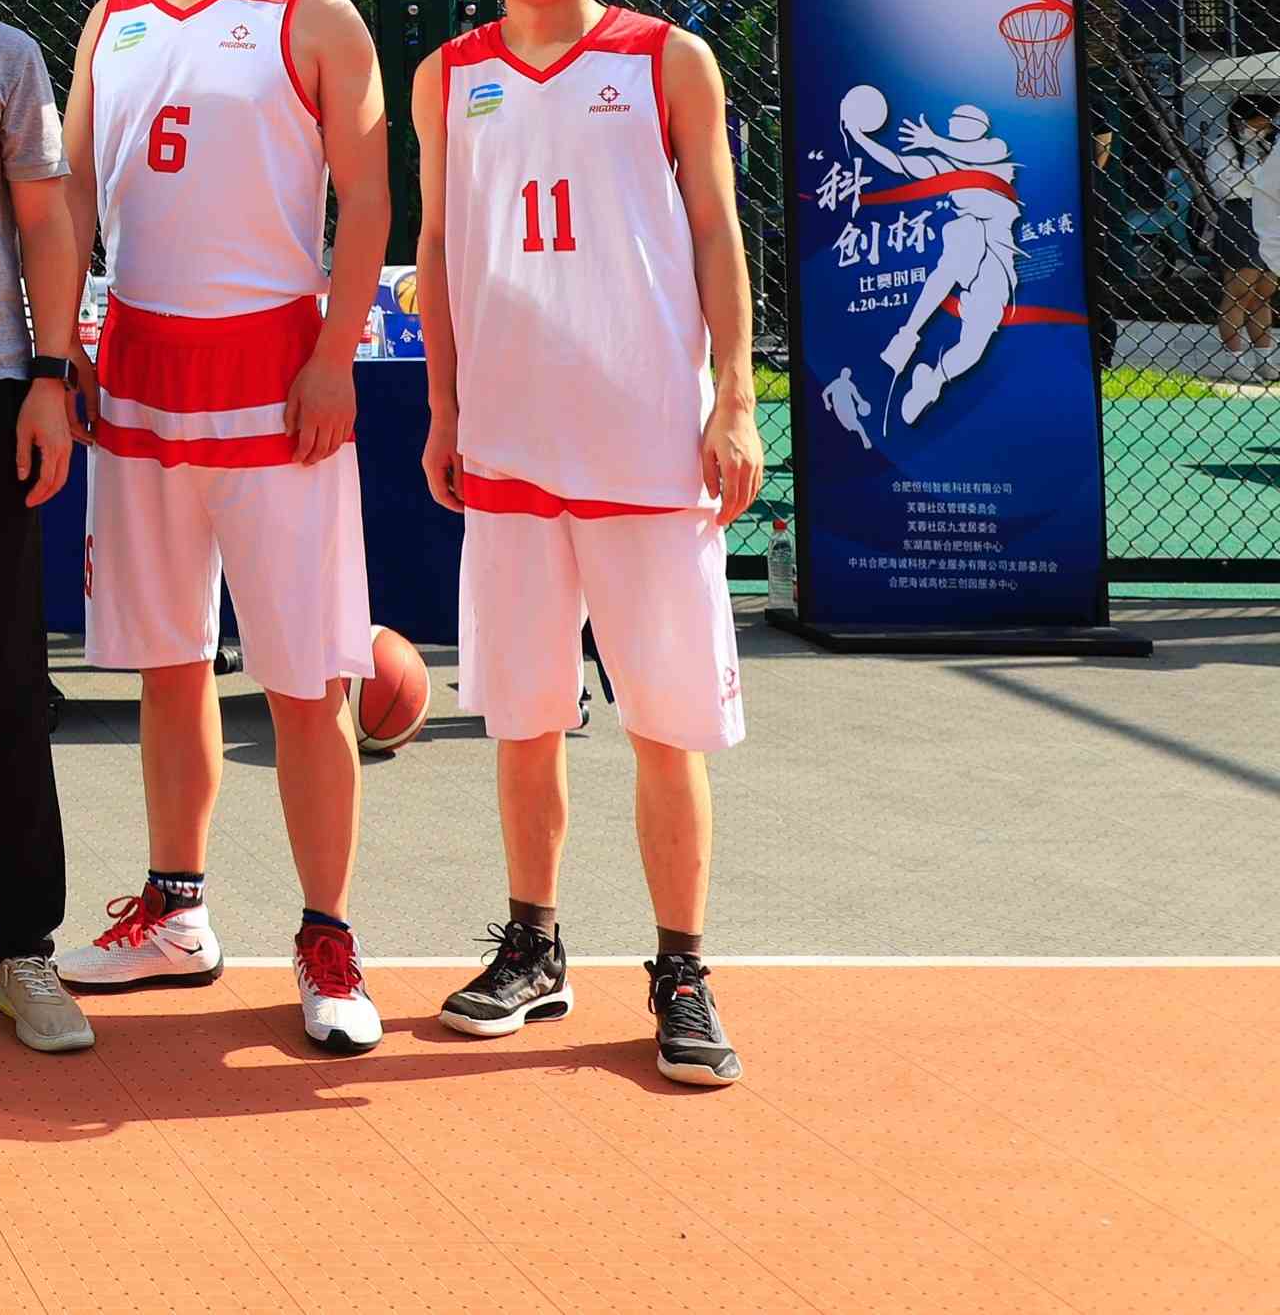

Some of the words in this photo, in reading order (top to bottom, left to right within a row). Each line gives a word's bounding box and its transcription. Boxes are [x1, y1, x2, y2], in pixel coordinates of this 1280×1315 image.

[588, 104, 631, 113] RIGORER
[147, 105, 190, 173] 6
[522, 179, 576, 252] 11
[1019, 212, 1074, 242] 篮球赛
[859, 267, 926, 293] 比赛时间
[847, 291, 909, 313] 4.20-4.21
[906, 502, 997, 515] 芙蓉社区管理委员会
